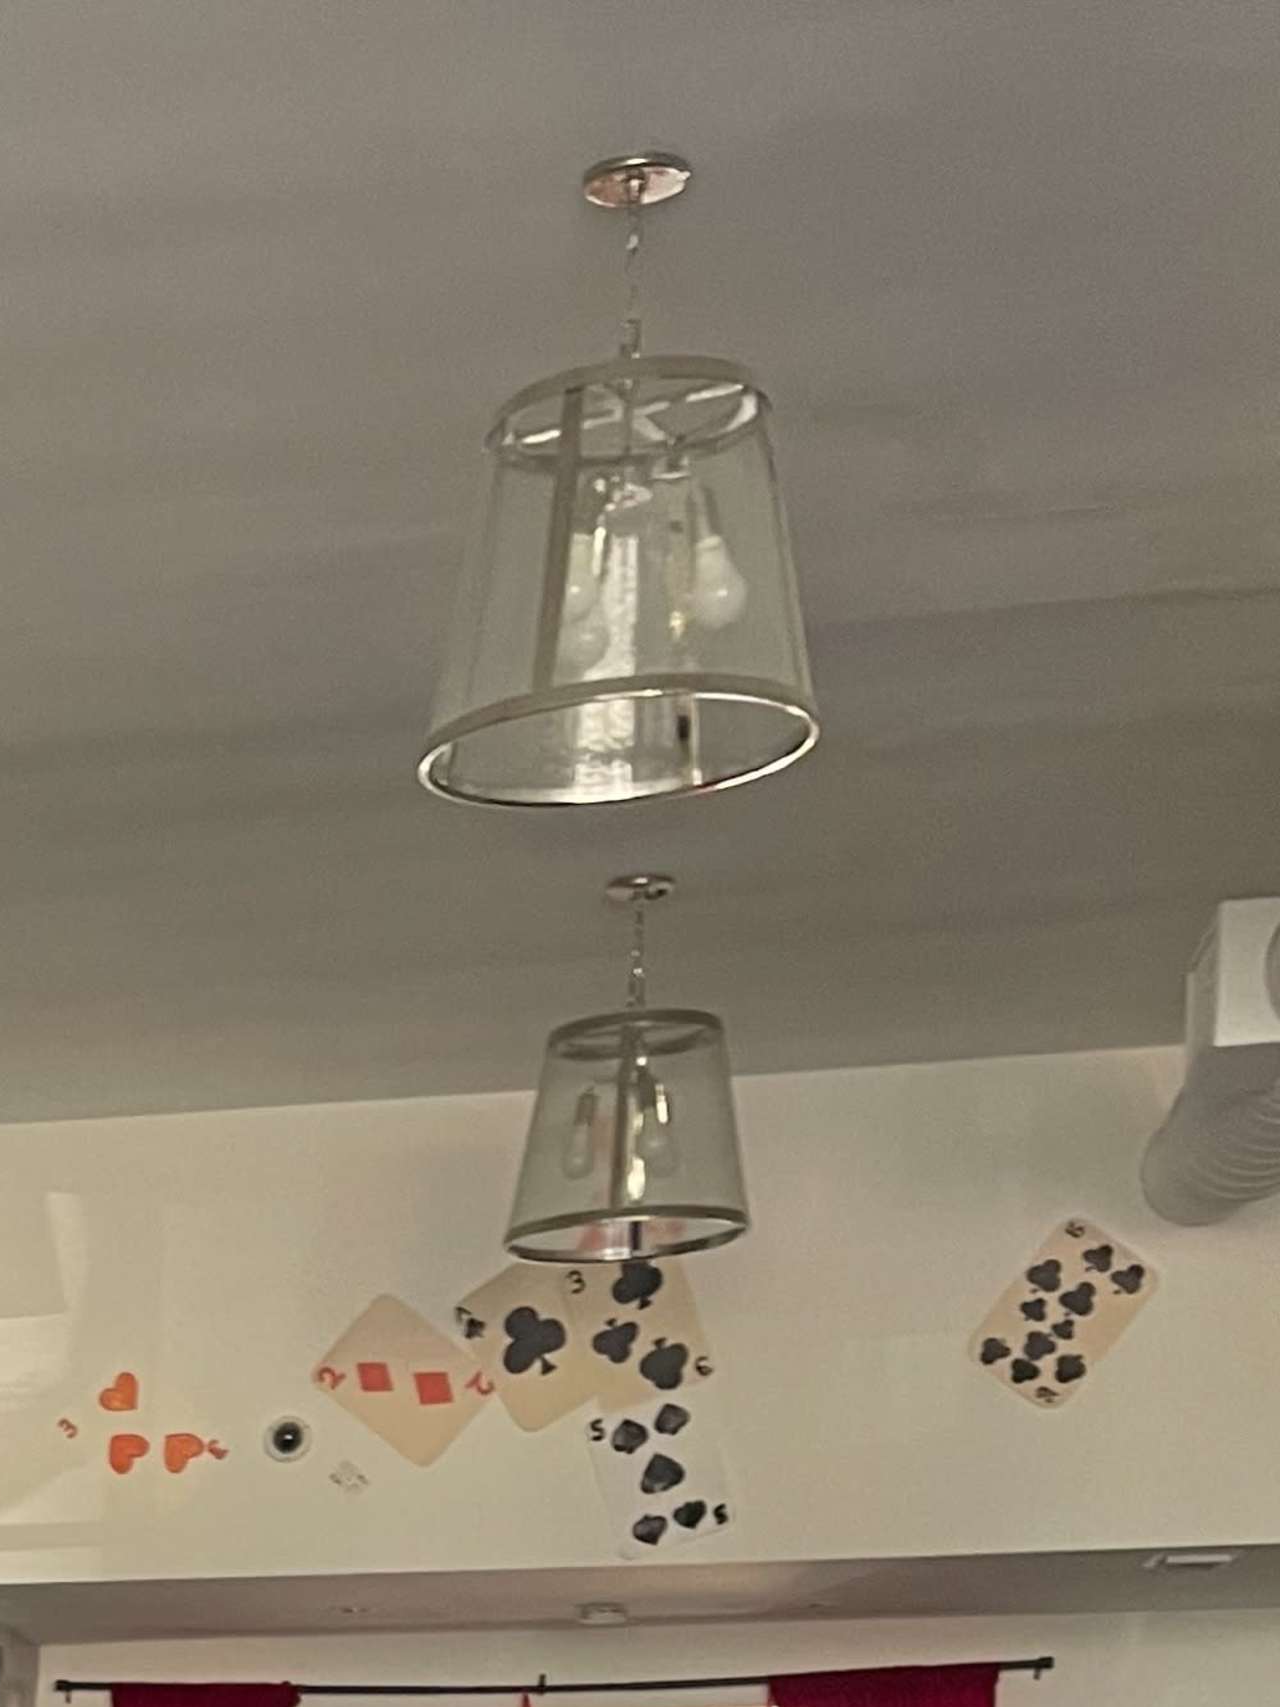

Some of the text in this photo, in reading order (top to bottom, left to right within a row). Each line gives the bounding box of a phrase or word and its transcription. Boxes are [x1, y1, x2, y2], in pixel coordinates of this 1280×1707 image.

[567, 1269, 587, 1294] 3
[317, 1366, 347, 1391] 2
[465, 1370, 495, 1395] 2
[57, 1417, 78, 1439] 3
[590, 1417, 605, 1442] 5
